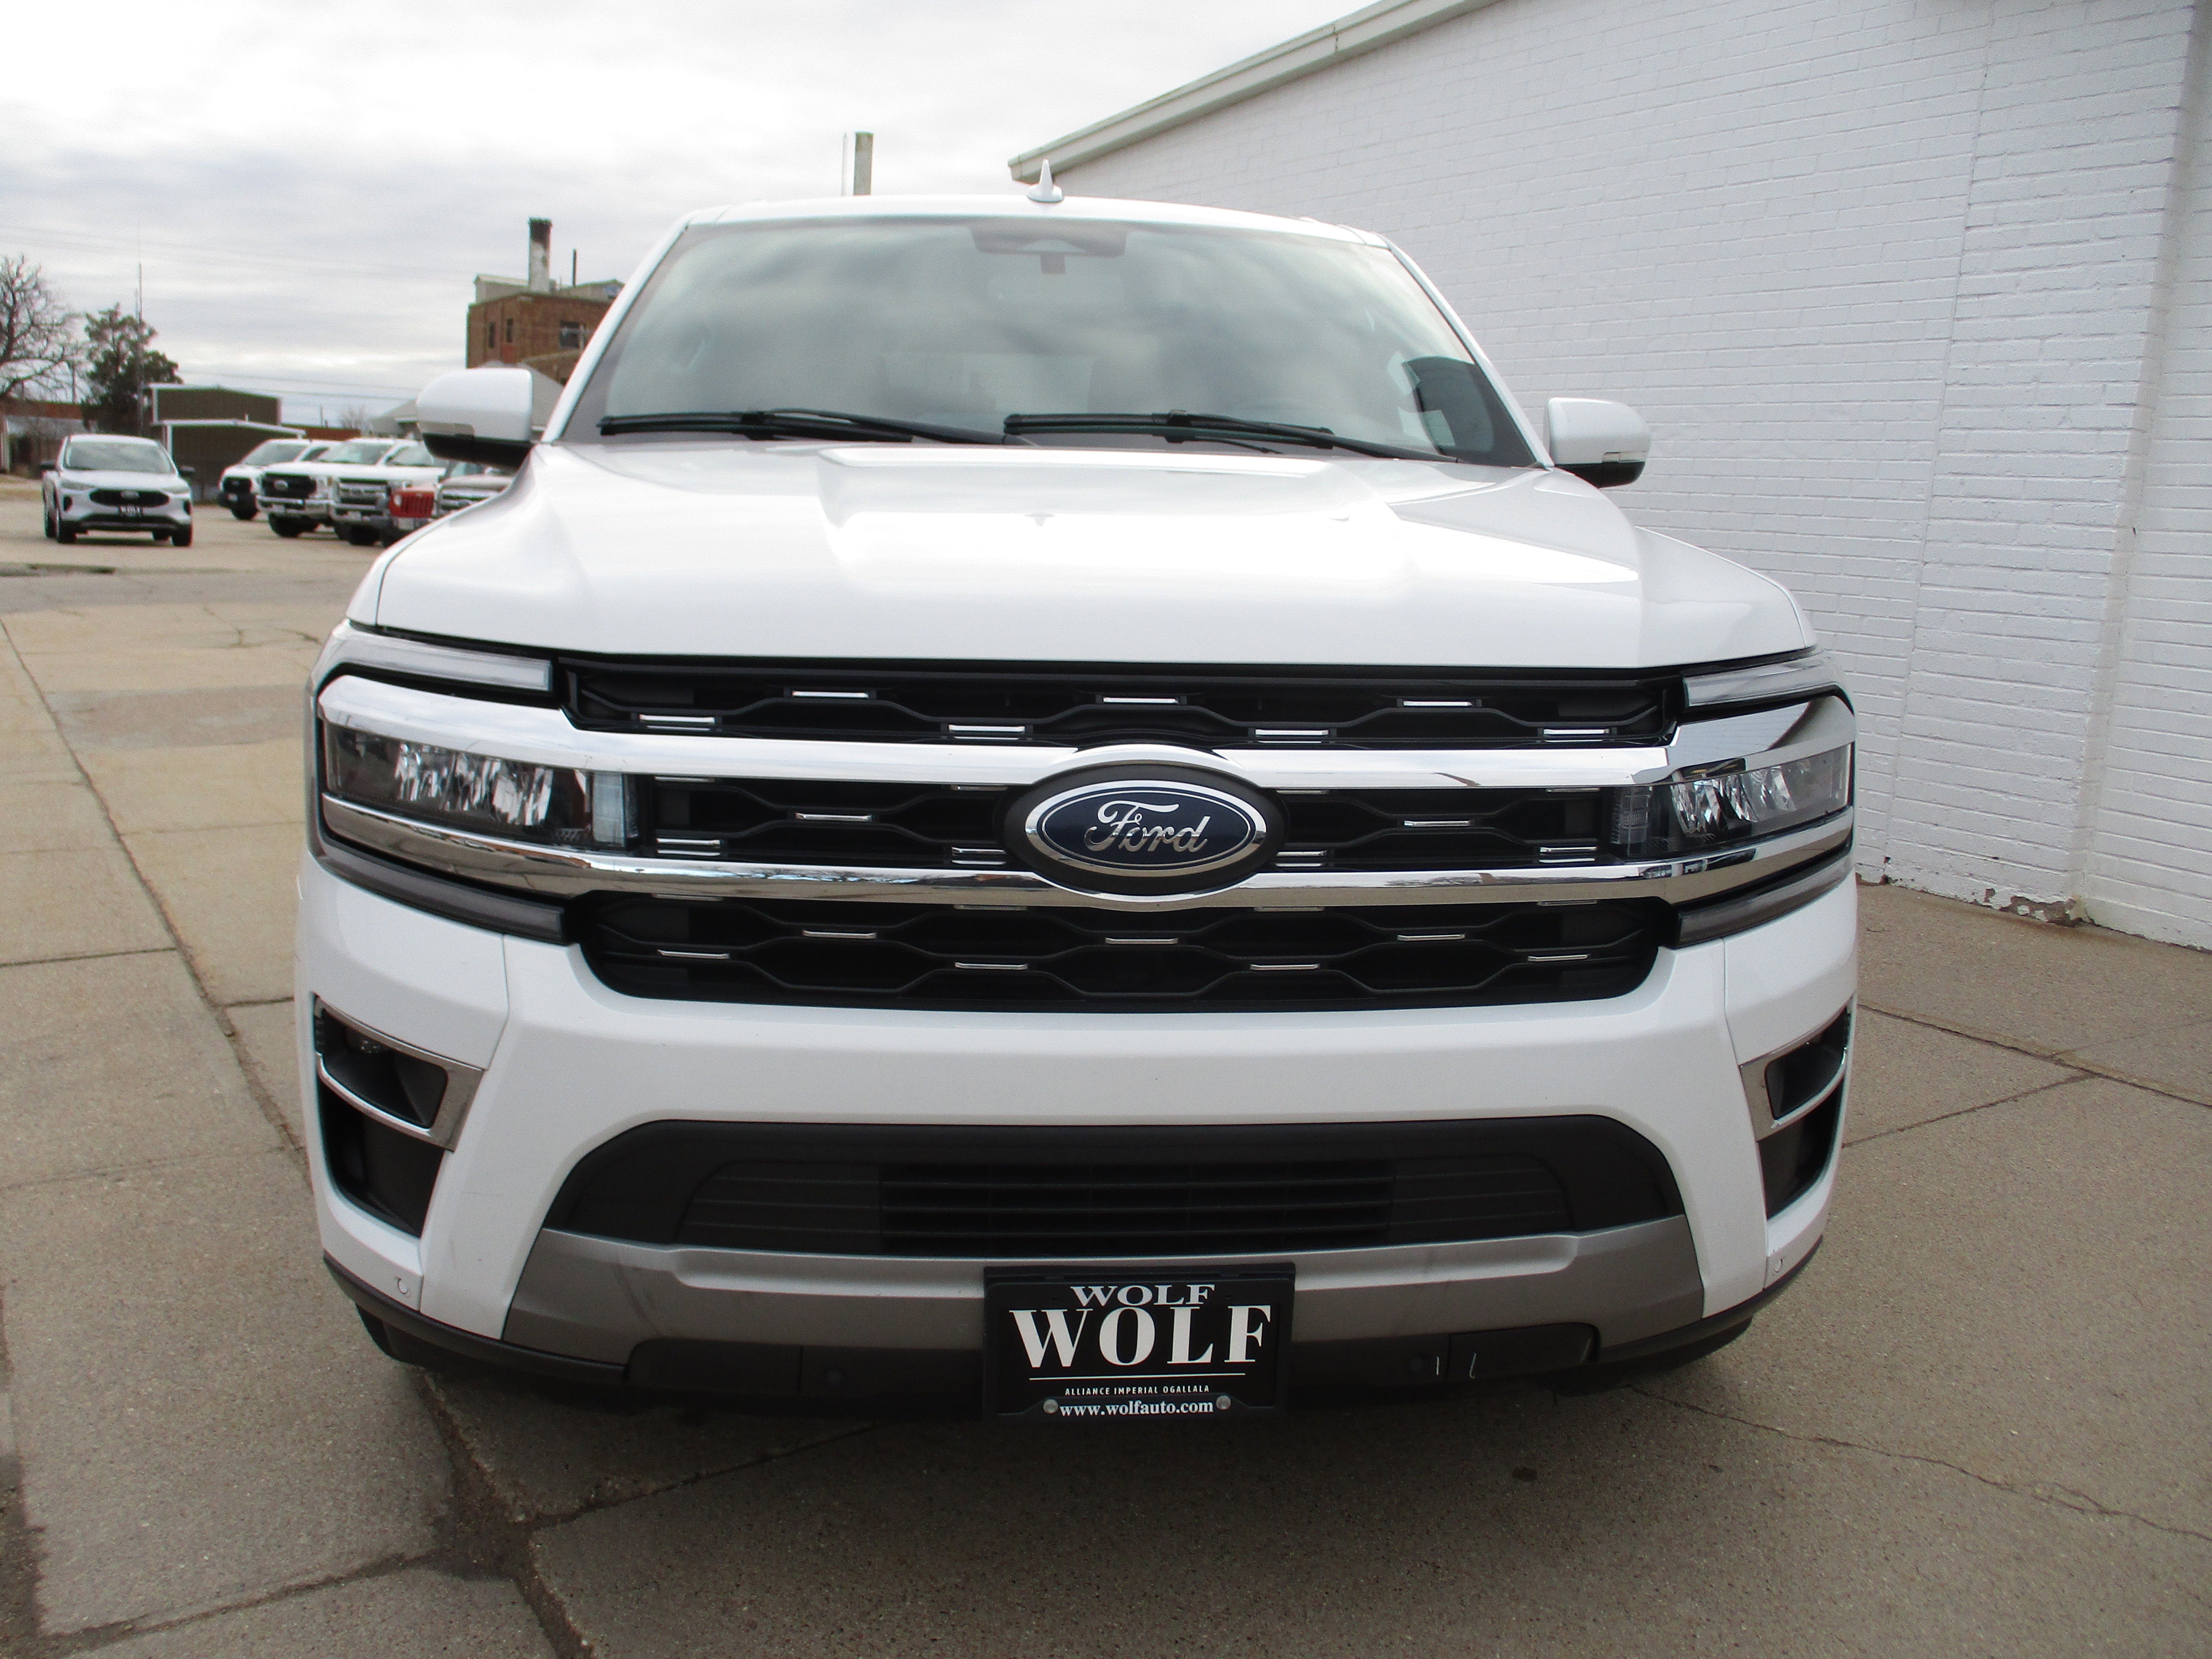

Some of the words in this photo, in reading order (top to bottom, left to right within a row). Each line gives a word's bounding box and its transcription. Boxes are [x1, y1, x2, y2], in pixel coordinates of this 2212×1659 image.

[1084, 800, 1211, 853] Ford
[1070, 1284, 1215, 1307] WOLF
[1009, 1305, 1271, 1368] WOLF
[1065, 1387, 1110, 1396] ALLIANCE
[1114, 1386, 1158, 1395] IMPERIAL
[1163, 1385, 1209, 1393] OGALLALA
[1060, 1400, 1214, 1416] www.wolfauto.com
